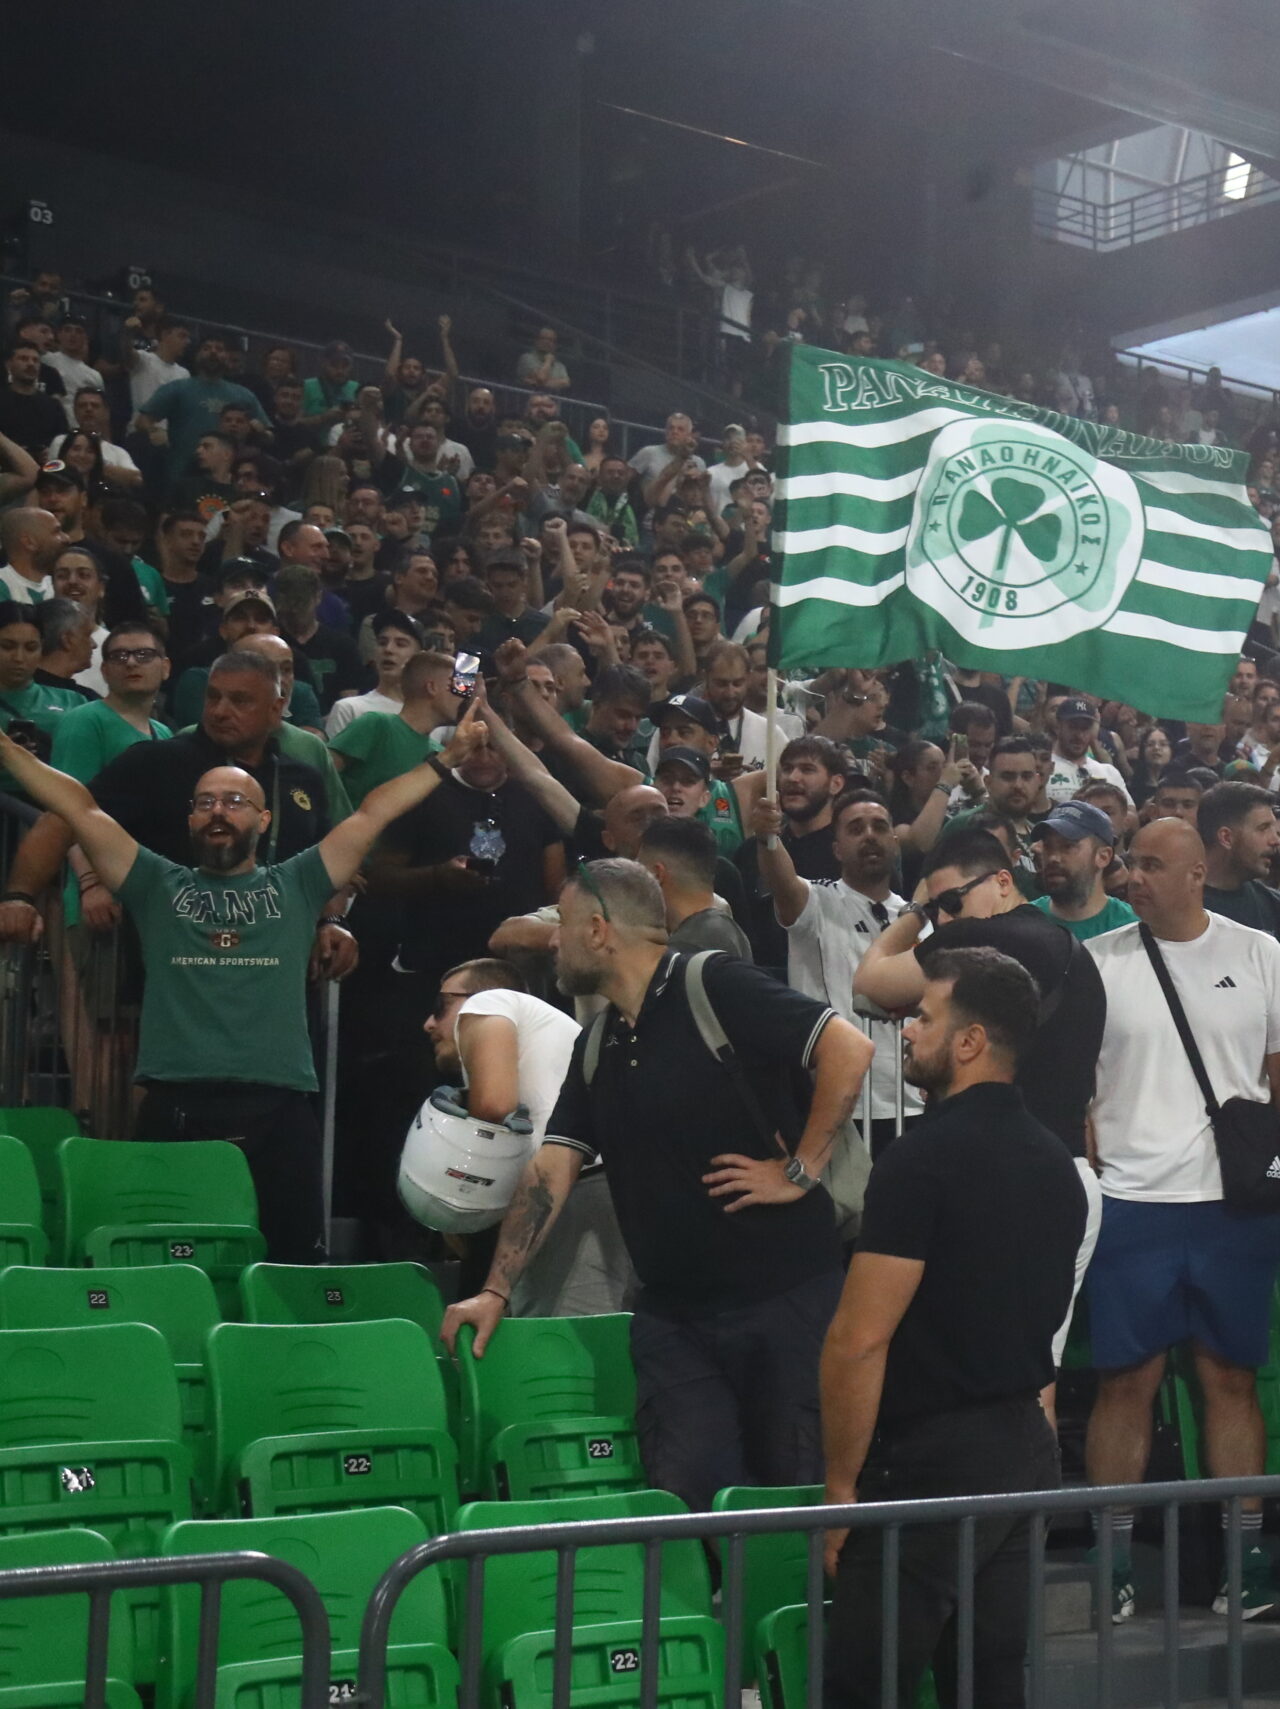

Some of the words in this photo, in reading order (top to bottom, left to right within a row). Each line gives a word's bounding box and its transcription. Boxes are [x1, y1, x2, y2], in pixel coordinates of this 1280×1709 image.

[30, 207, 53, 224] 03
[959, 575, 1018, 612] 1908
[172, 882, 281, 925] GANT
[171, 957, 216, 966] AMERICAN
[218, 957, 280, 967] SPORTSWEAR
[174, 1245, 192, 1257] 23
[90, 1293, 107, 1305] 22
[327, 1291, 342, 1301] 23
[592, 1442, 611, 1457] 23
[348, 1458, 369, 1473] 22
[614, 1652, 637, 1671] 22
[328, 1683, 352, 1704] 21
